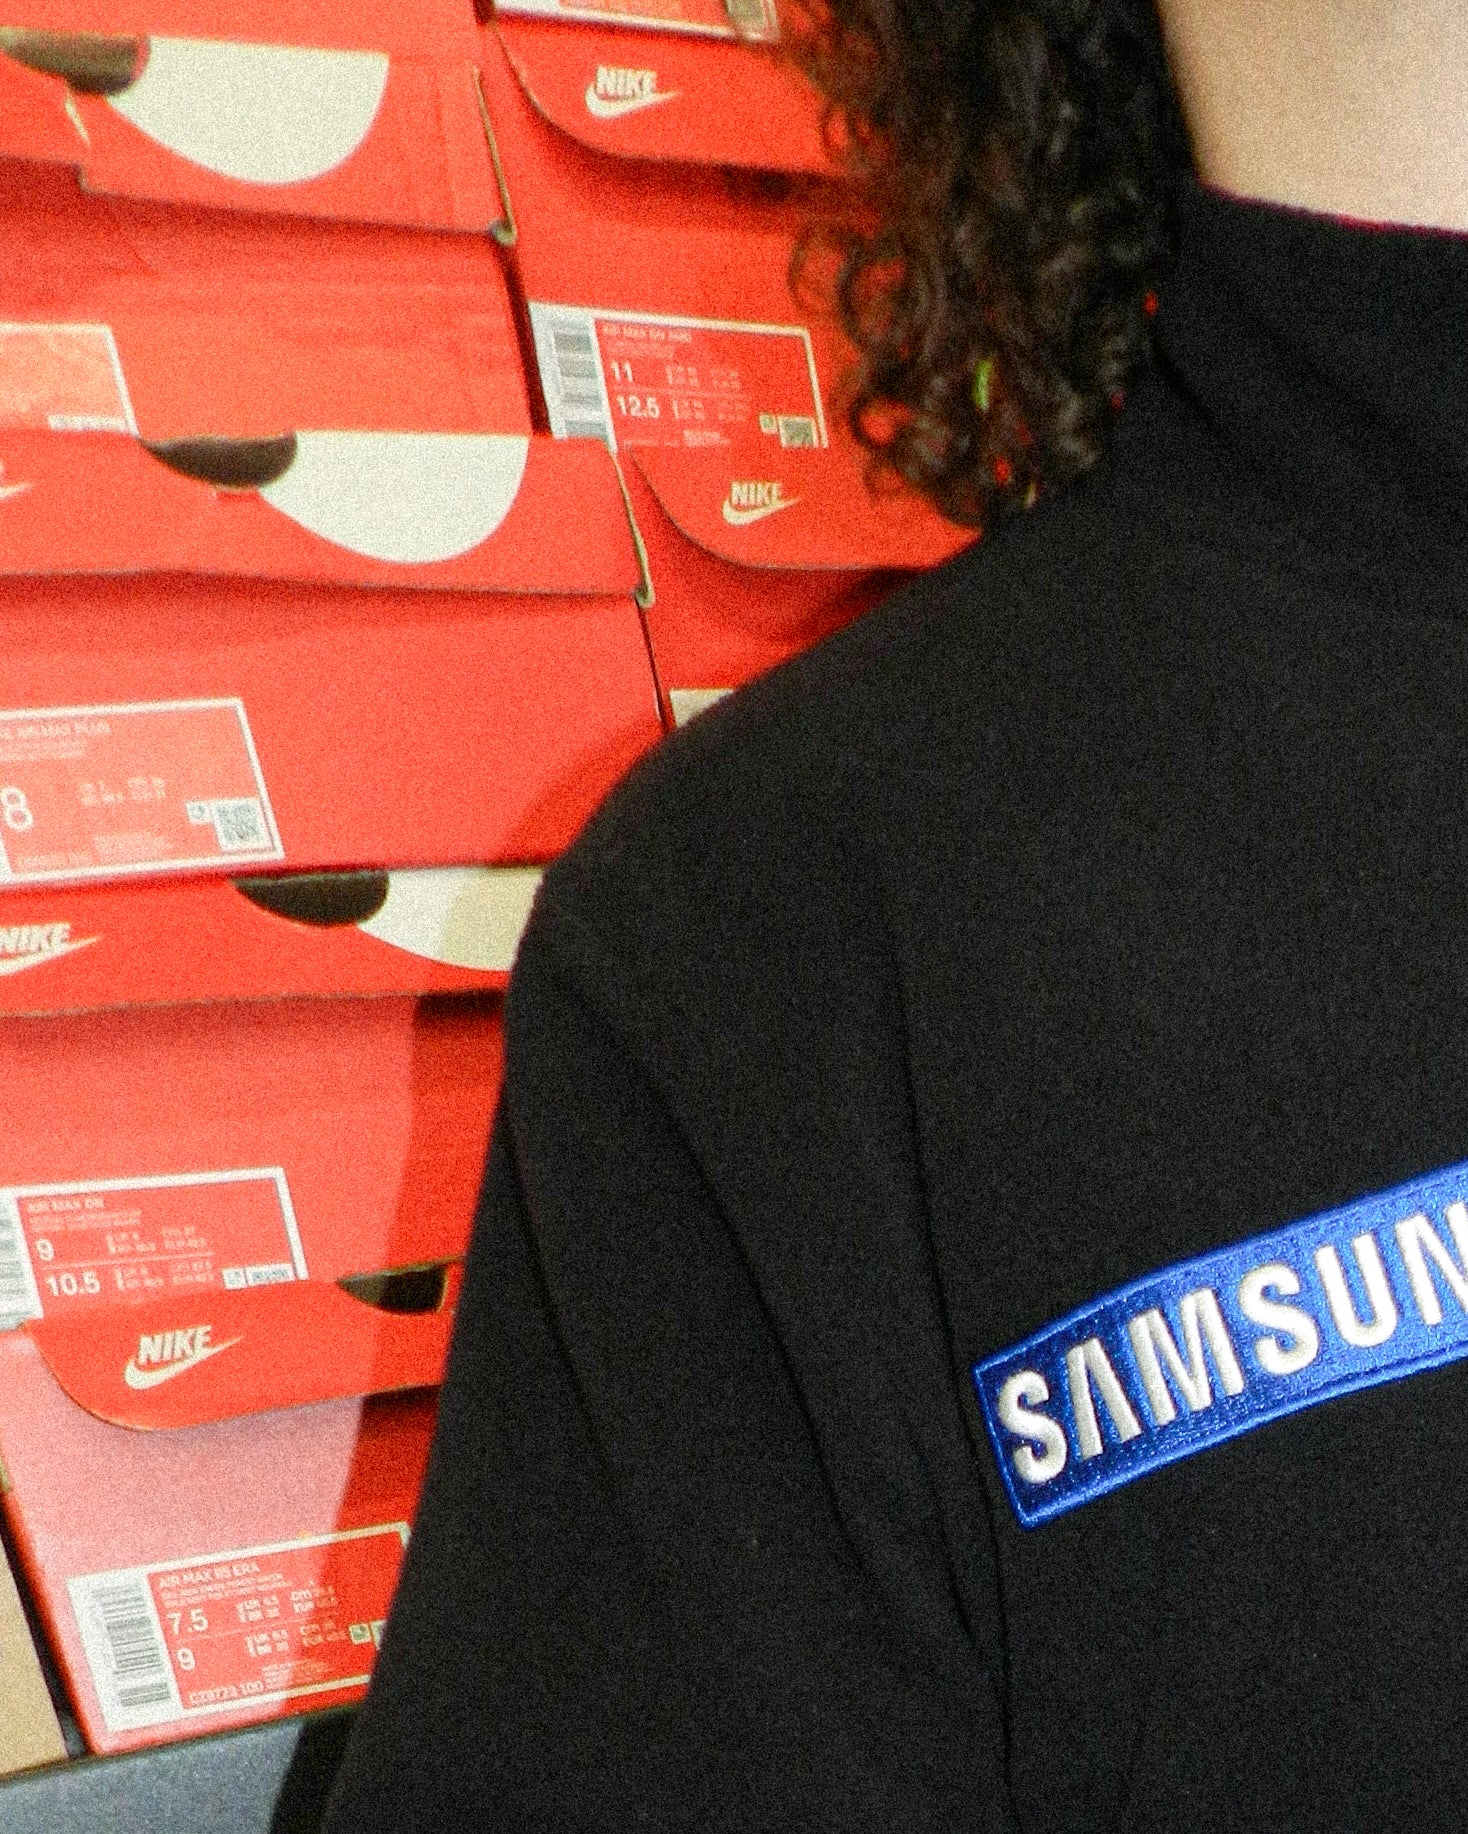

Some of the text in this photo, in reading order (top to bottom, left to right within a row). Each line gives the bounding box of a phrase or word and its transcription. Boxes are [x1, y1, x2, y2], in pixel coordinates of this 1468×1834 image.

[596, 64, 657, 99] NIKE
[610, 361, 633, 383] 11
[617, 395, 660, 418] 12.5
[730, 480, 781, 507] NIKE
[0, 921, 71, 955] NIKE
[35, 1238, 54, 1261] 9
[46, 1270, 101, 1296] 10.5
[138, 1325, 212, 1365] NIKE
[159, 1574, 181, 1589] AIR
[182, 1570, 213, 1584] MAX
[167, 1608, 209, 1636] 7.5
[176, 1647, 196, 1671] 9
